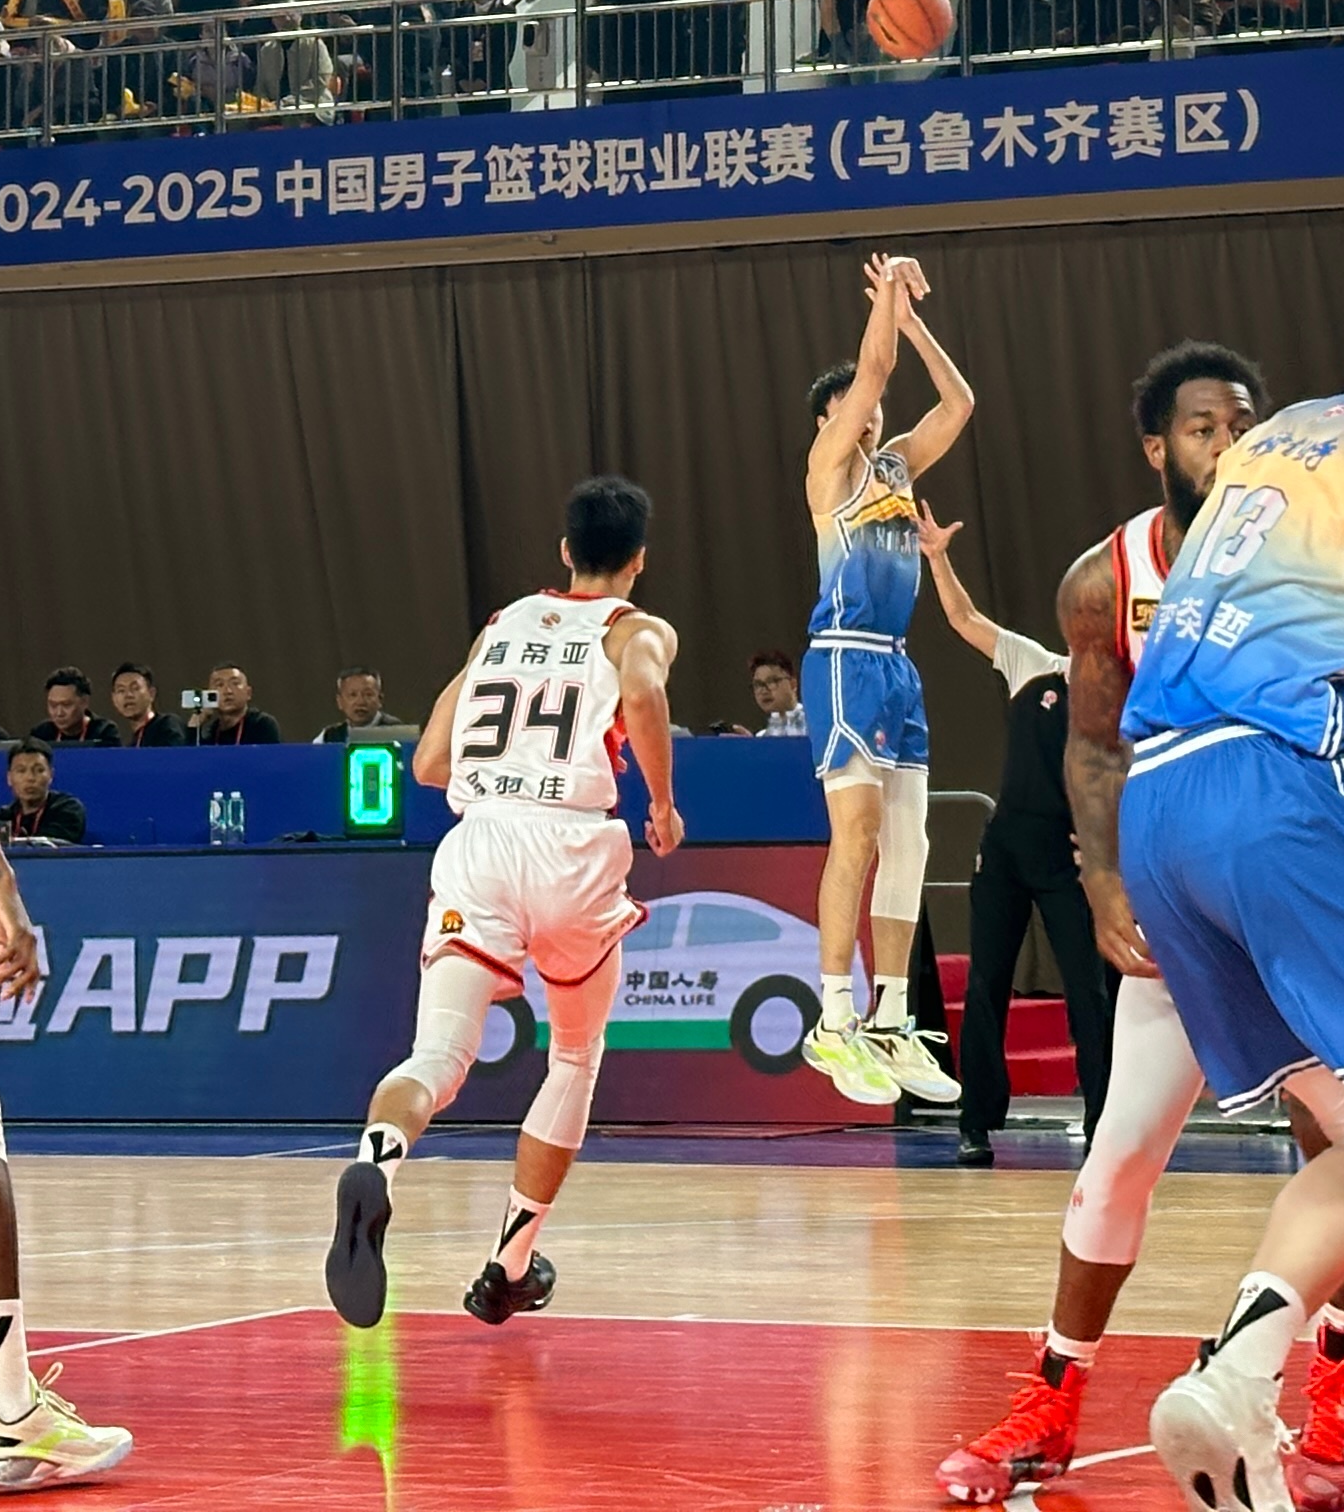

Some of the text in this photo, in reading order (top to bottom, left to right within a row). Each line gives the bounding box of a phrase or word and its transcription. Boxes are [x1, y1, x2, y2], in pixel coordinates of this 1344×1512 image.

[1191, 485, 1289, 580] 13
[481, 641, 591, 667] 肯帝亚
[459, 678, 585, 765] 34
[626, 969, 719, 992] 中国人寿
[623, 992, 716, 1006] CHINA LIFE
